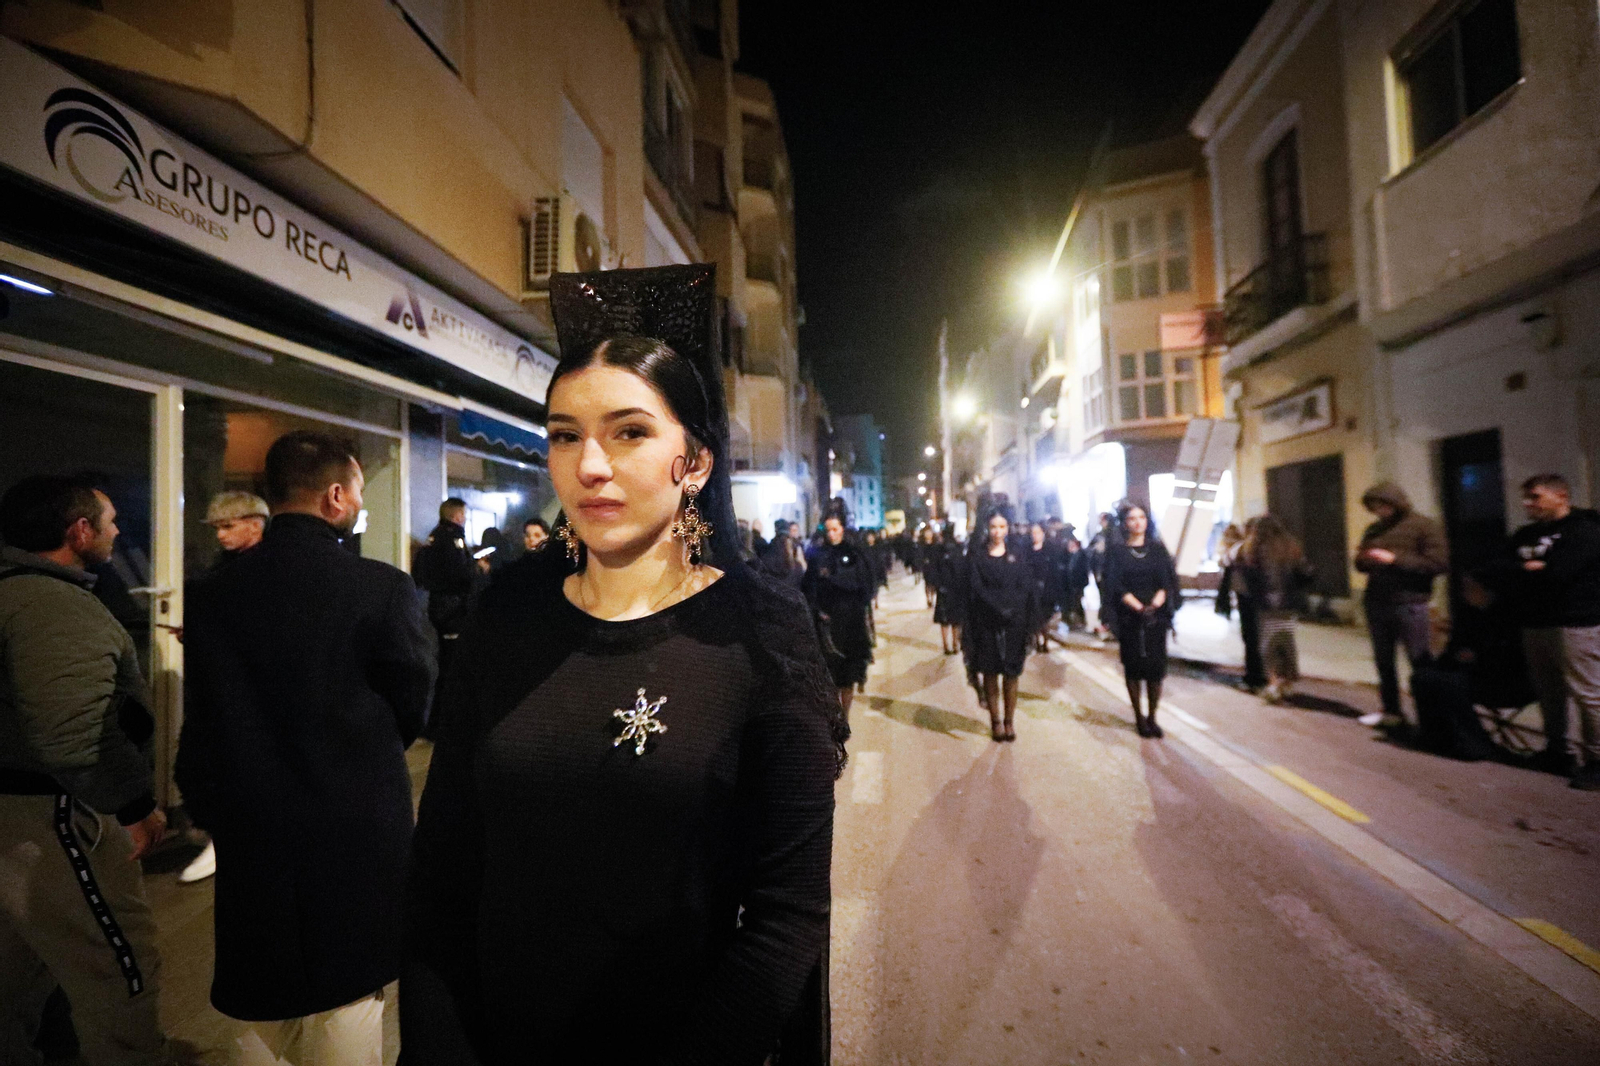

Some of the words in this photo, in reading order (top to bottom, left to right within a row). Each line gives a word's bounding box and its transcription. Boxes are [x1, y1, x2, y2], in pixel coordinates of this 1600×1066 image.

[113, 166, 229, 242] ASESORES
[150, 149, 275, 239] GRUPO
[286, 220, 352, 281] RECA
